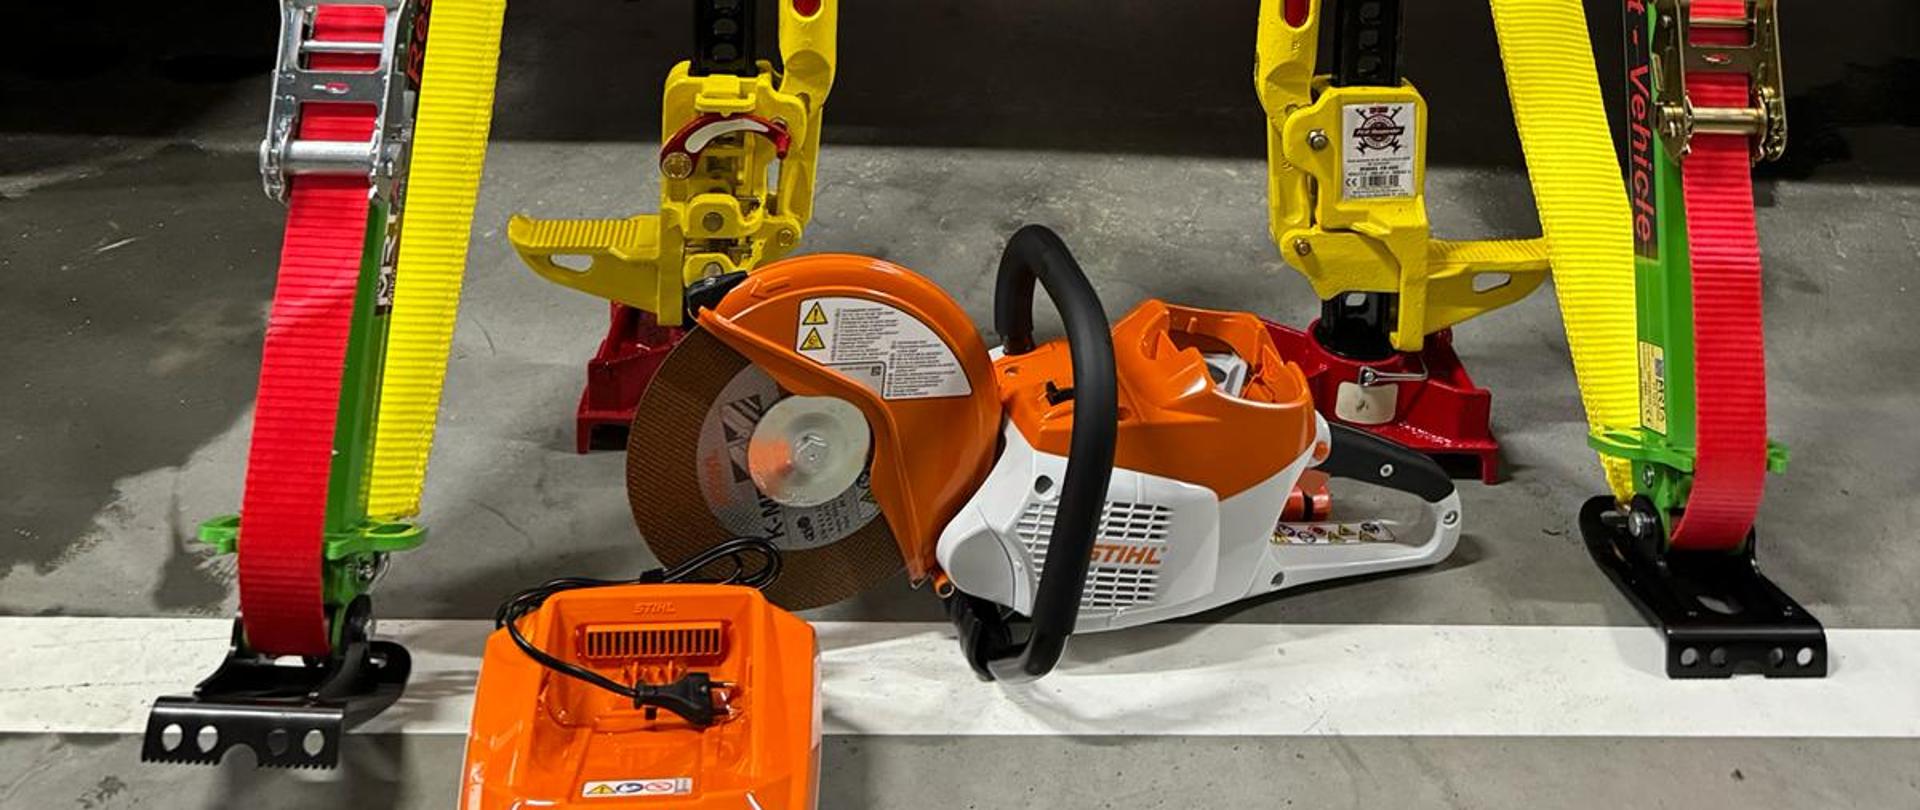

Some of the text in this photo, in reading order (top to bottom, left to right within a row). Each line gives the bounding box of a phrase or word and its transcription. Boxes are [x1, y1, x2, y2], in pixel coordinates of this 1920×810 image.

[1628, 64, 1656, 243] Vehicle
[1090, 544, 1161, 565] STIHL
[632, 601, 676, 615] STIHL
